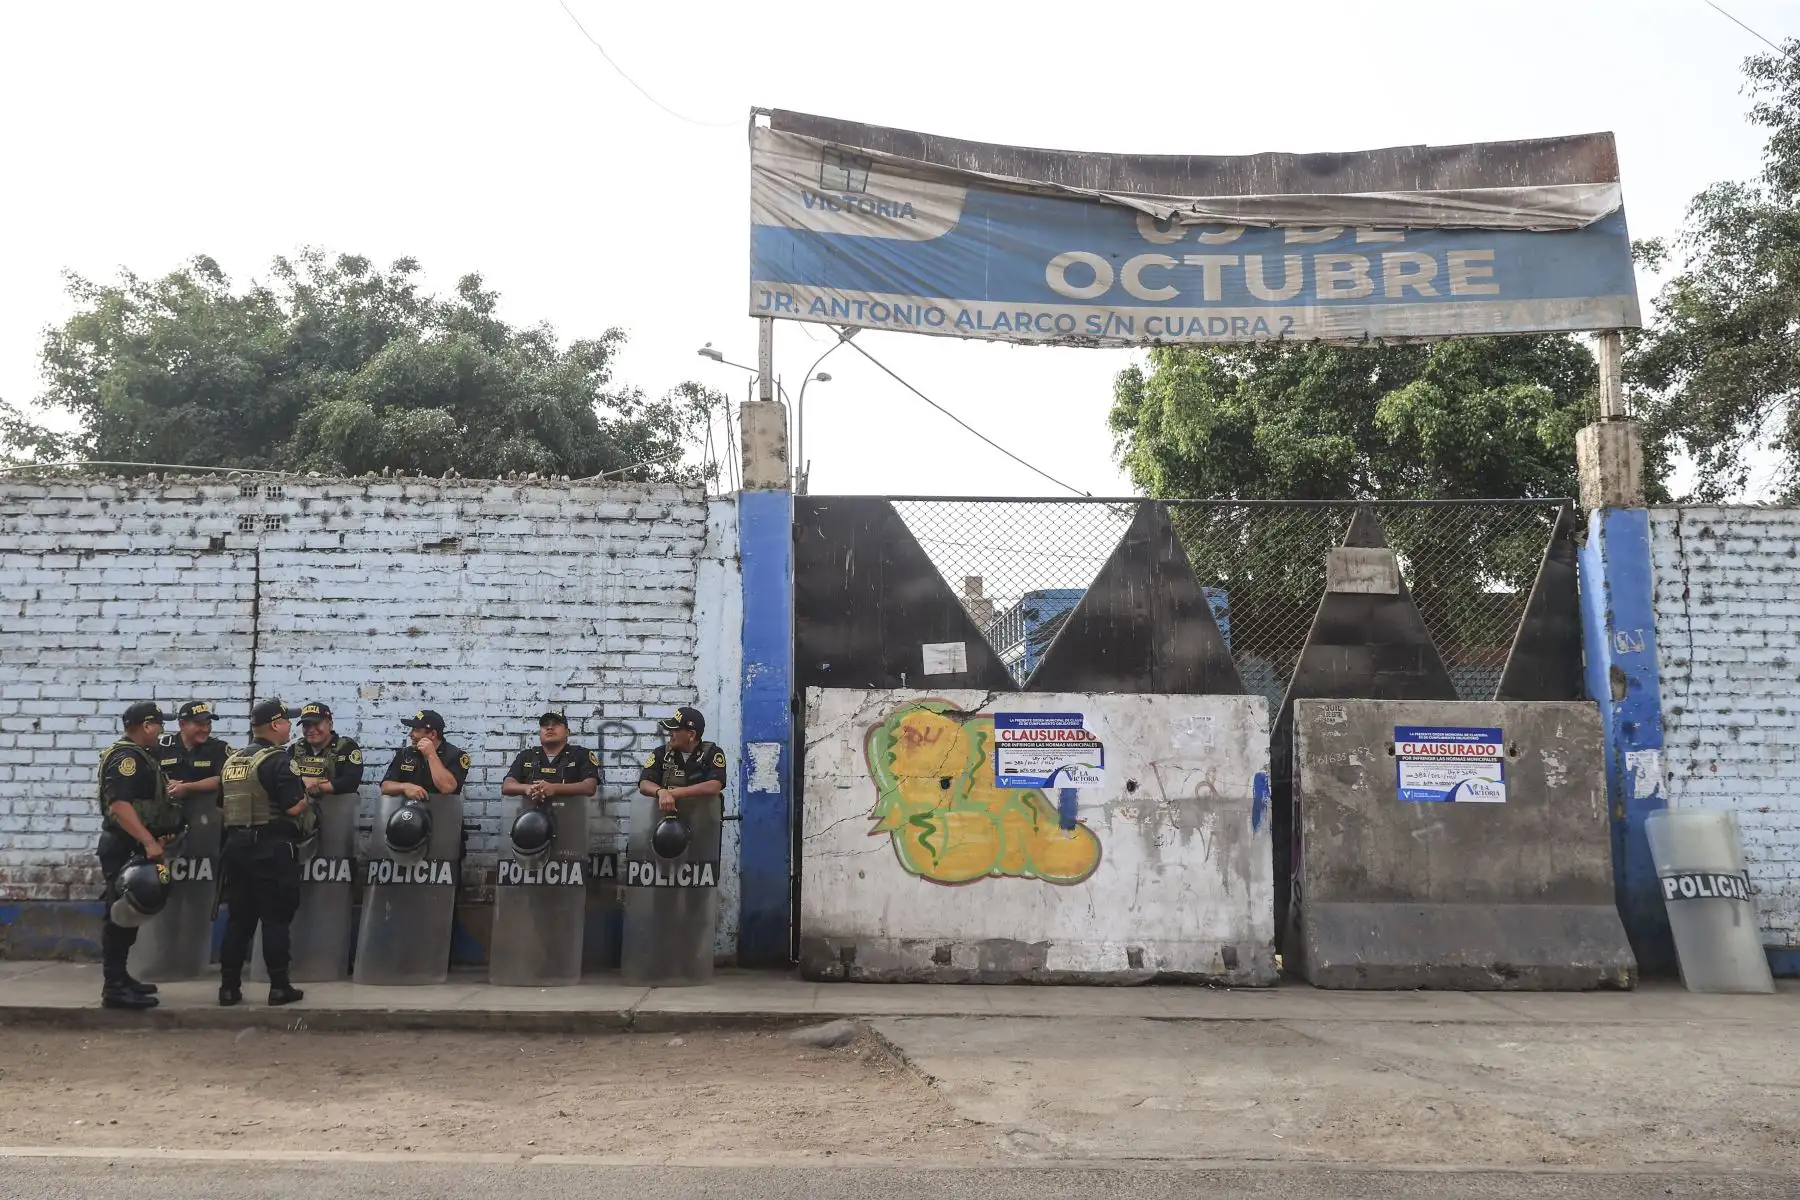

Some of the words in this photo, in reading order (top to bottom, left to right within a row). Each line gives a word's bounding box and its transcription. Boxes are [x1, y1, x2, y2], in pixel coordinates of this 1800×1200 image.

[801, 190, 917, 219] VICTORIA
[1046, 249, 1500, 302] OCTUBRE
[758, 290, 799, 314] JR.
[808, 296, 945, 326] ANTONIO
[954, 308, 1076, 334] ALARCO
[1086, 311, 1134, 337] S/N
[1143, 315, 1270, 337] CUADRA
[1278, 315, 1296, 336] 2
[1001, 730, 1097, 741] CLAUSURADO
[1402, 743, 1497, 755] CLAUSURADO
[224, 766, 247, 779] POLICIA
[367, 860, 453, 884] POLICIA
[498, 861, 584, 885] POLICIA
[628, 861, 715, 886] POLICIA
[1661, 875, 1749, 900] POLICIA
